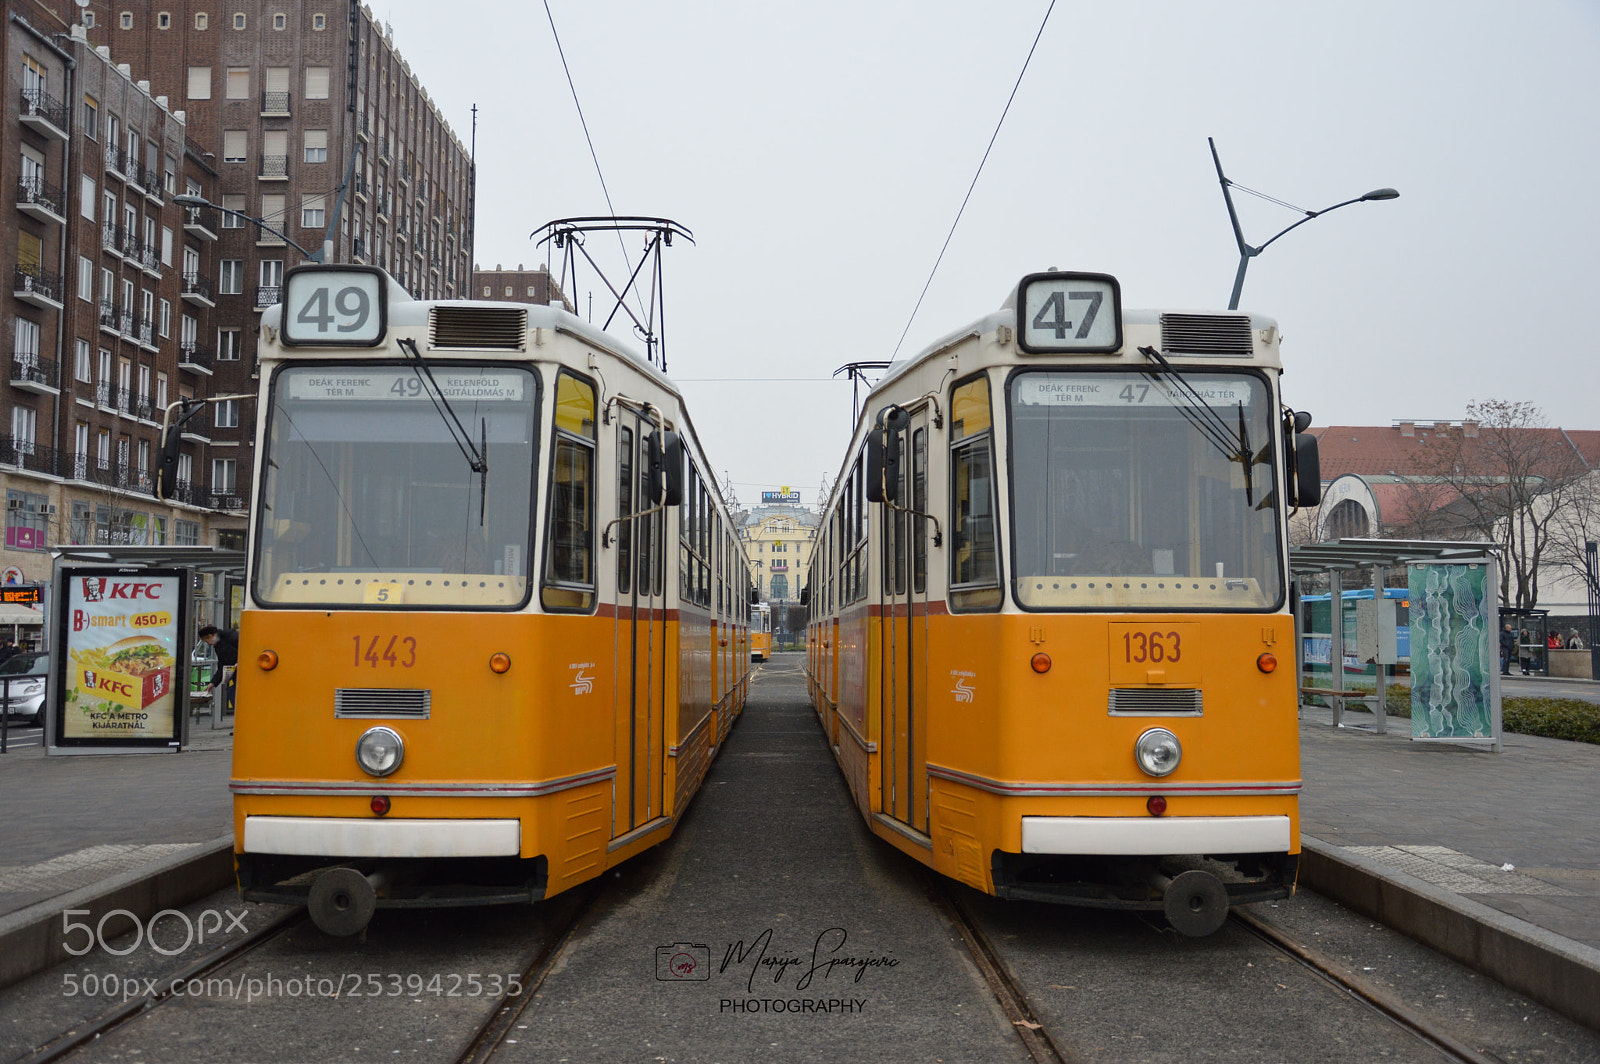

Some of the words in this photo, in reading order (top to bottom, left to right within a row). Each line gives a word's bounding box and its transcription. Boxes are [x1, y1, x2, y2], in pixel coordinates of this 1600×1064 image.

[297, 286, 370, 333] 49
[1033, 291, 1103, 339] 47
[308, 377, 333, 387] DEÁK
[336, 378, 371, 387] FERENC
[390, 377, 422, 397] 49
[447, 378, 499, 387] KELENFÖLD
[1038, 383, 1063, 393] DEÁK
[1066, 384, 1100, 393] FERENC
[326, 387, 343, 396] TÉR
[345, 388, 354, 396] M
[506, 388, 515, 396] M
[1055, 393, 1073, 402] TÉR
[1074, 394, 1084, 402] M
[1118, 384, 1151, 403] 47
[1218, 389, 1235, 398] TÉR
[109, 583, 162, 599] KFC
[377, 588, 389, 601] 5
[91, 614, 126, 627] smart
[134, 614, 157, 627] 450
[353, 635, 417, 668] 1443
[1123, 631, 1181, 663] 1363
[98, 677, 133, 698] KFC
[92, 720, 145, 729] KIJÁRATNÁL
